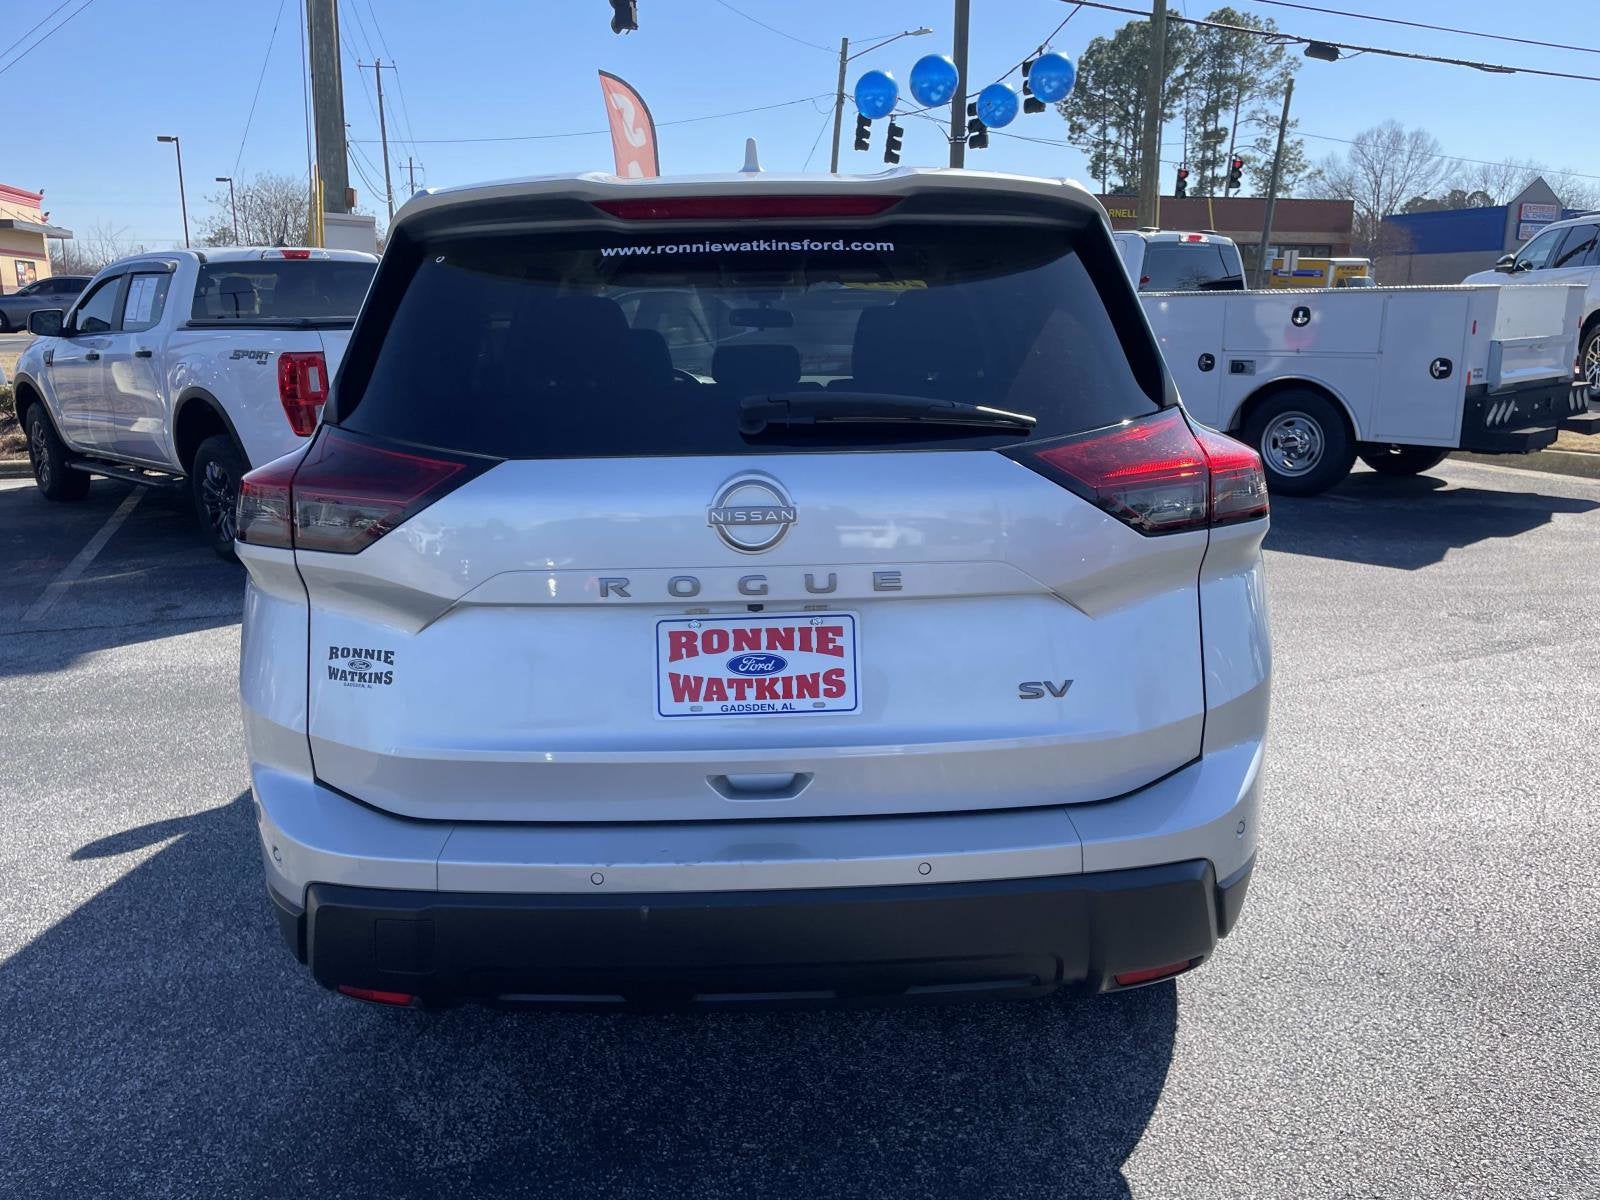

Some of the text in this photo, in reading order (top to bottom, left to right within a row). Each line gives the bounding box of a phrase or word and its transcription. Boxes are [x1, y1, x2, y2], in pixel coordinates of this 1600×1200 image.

[1108, 208, 1138, 218] RNELL
[601, 239, 895, 257] www.ronniewatkinsford.com
[229, 350, 273, 360] SPORT
[711, 509, 795, 522] NISSAN
[598, 571, 903, 598] ROGUE
[668, 626, 844, 663] RONNIE
[328, 646, 394, 666] RONNIE
[738, 656, 775, 672] Ford
[328, 665, 393, 685] WATKINS
[668, 668, 847, 703] WATKINS
[1018, 679, 1074, 700] SV
[720, 702, 796, 713] GADSDEN, AL
